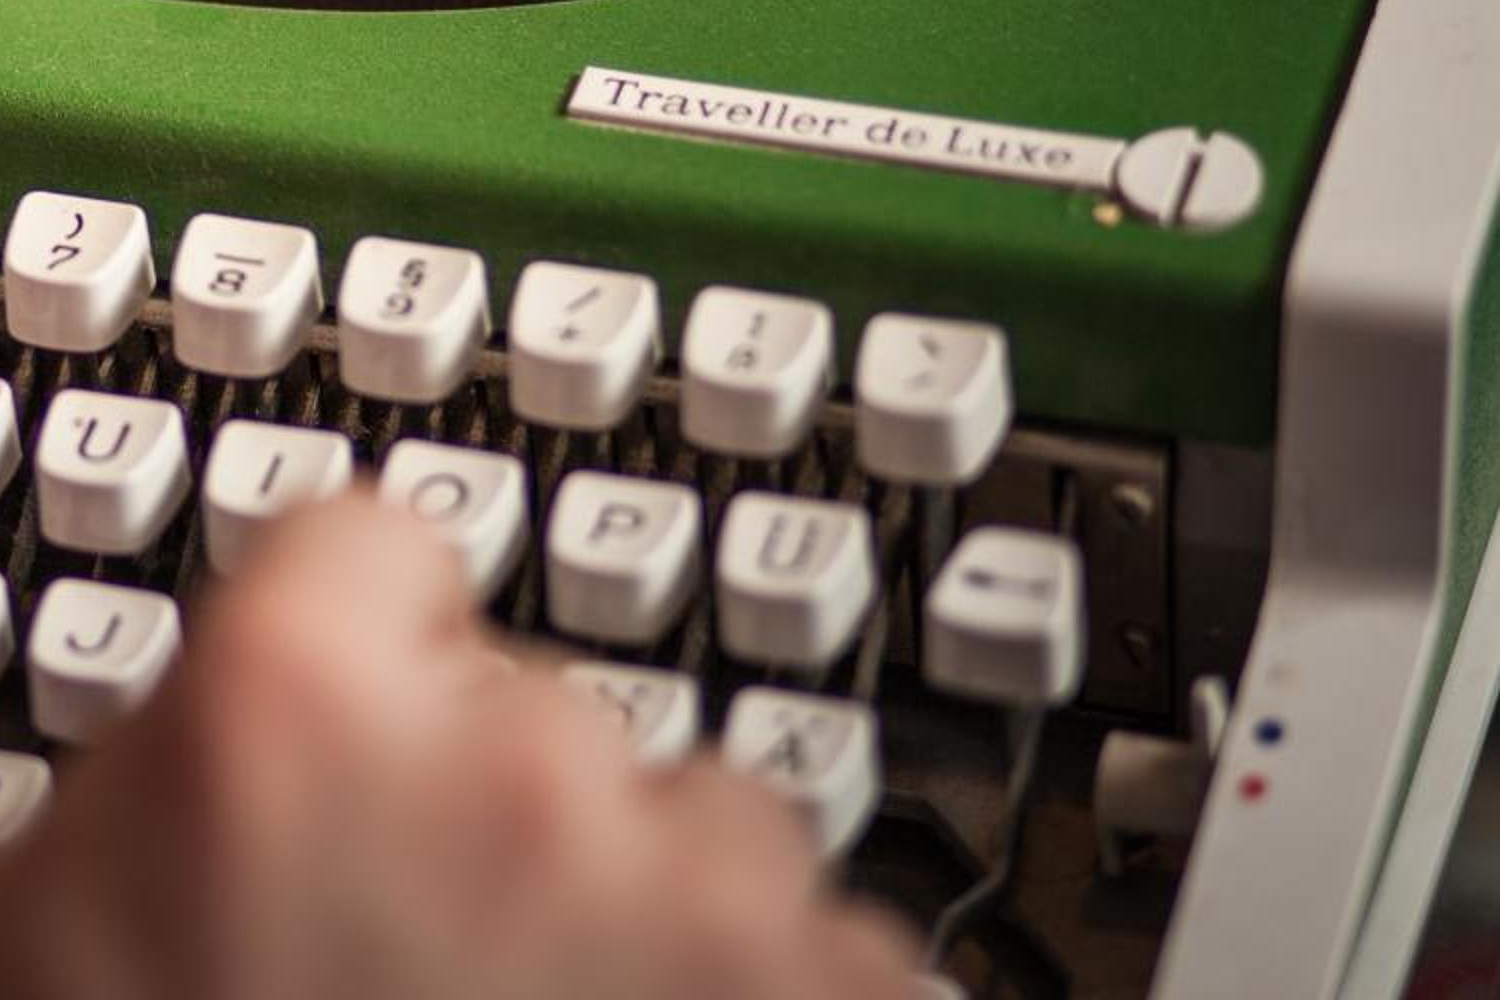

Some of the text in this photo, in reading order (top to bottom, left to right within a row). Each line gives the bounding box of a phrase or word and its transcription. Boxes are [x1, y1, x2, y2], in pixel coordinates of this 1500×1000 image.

[604, 77, 1073, 169] Traveller de Luxe
[46, 244, 81, 271] 7
[208, 268, 247, 298] 8
[77, 417, 132, 464] U
[261, 453, 285, 495] I
[410, 471, 470, 522] O
[588, 502, 648, 542] P
[65, 611, 123, 658] J
